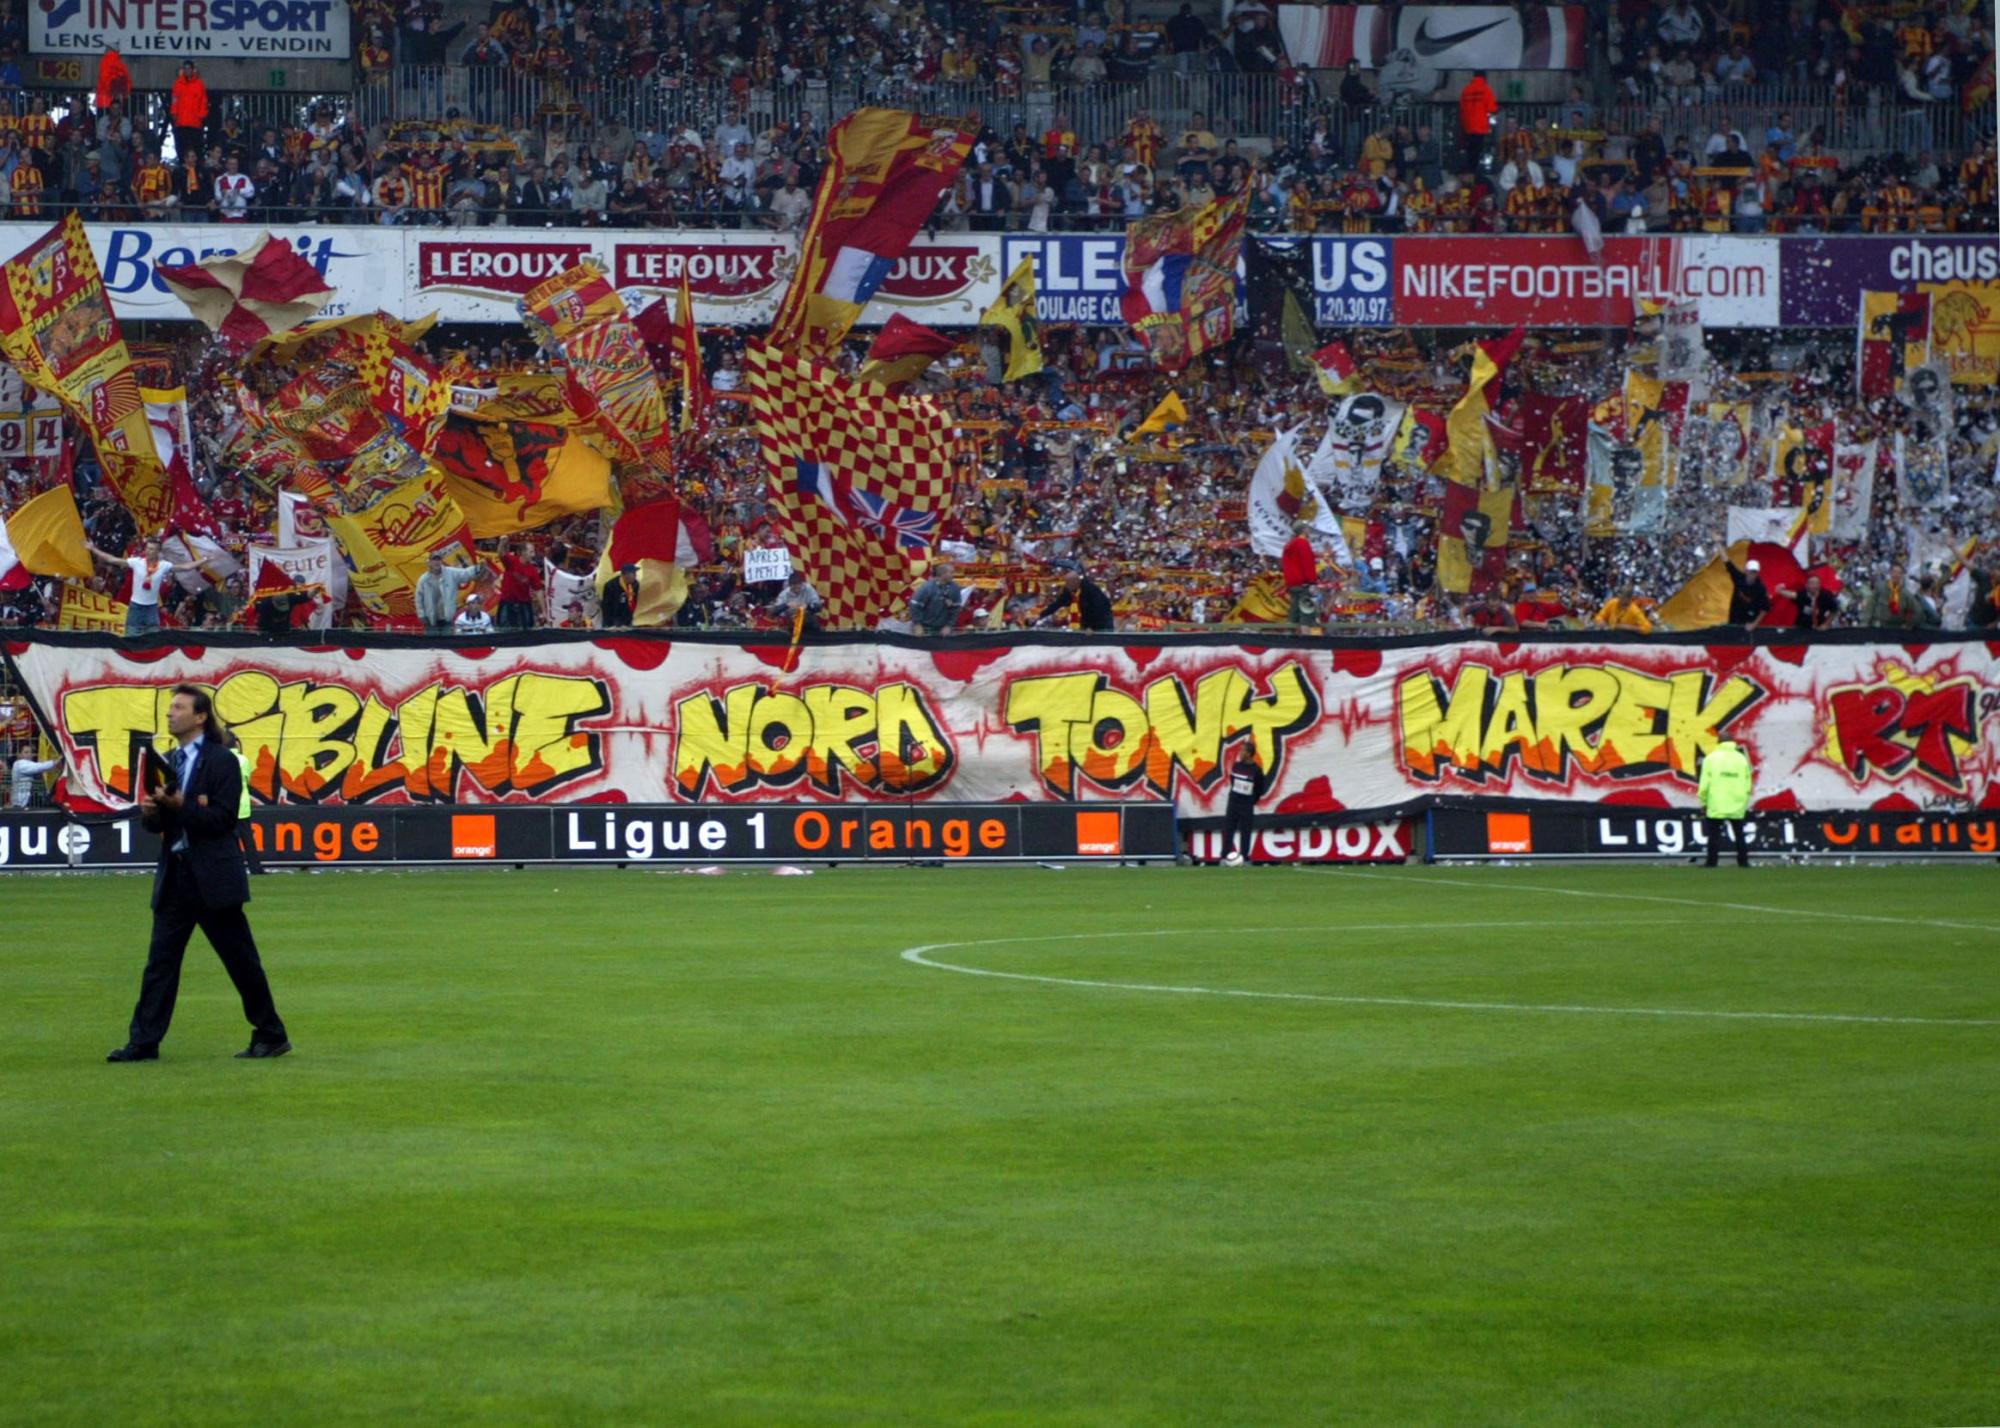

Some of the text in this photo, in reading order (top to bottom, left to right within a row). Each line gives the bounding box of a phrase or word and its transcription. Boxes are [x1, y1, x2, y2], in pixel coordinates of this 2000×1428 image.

[88, 0, 332, 31] INTERSPORT
[44, 33, 104, 48] LENS
[131, 32, 212, 51] LIÉVIN
[239, 36, 332, 52] VENDIN
[431, 252, 569, 277] LEROUX
[626, 254, 763, 279] LEROUX
[1006, 662, 1320, 799] TONY
[1401, 664, 1767, 784] MAREK
[568, 810, 1007, 859] Ligue 1 Orange
[454, 845, 493, 857] orange
[1077, 842, 1119, 854] orange
